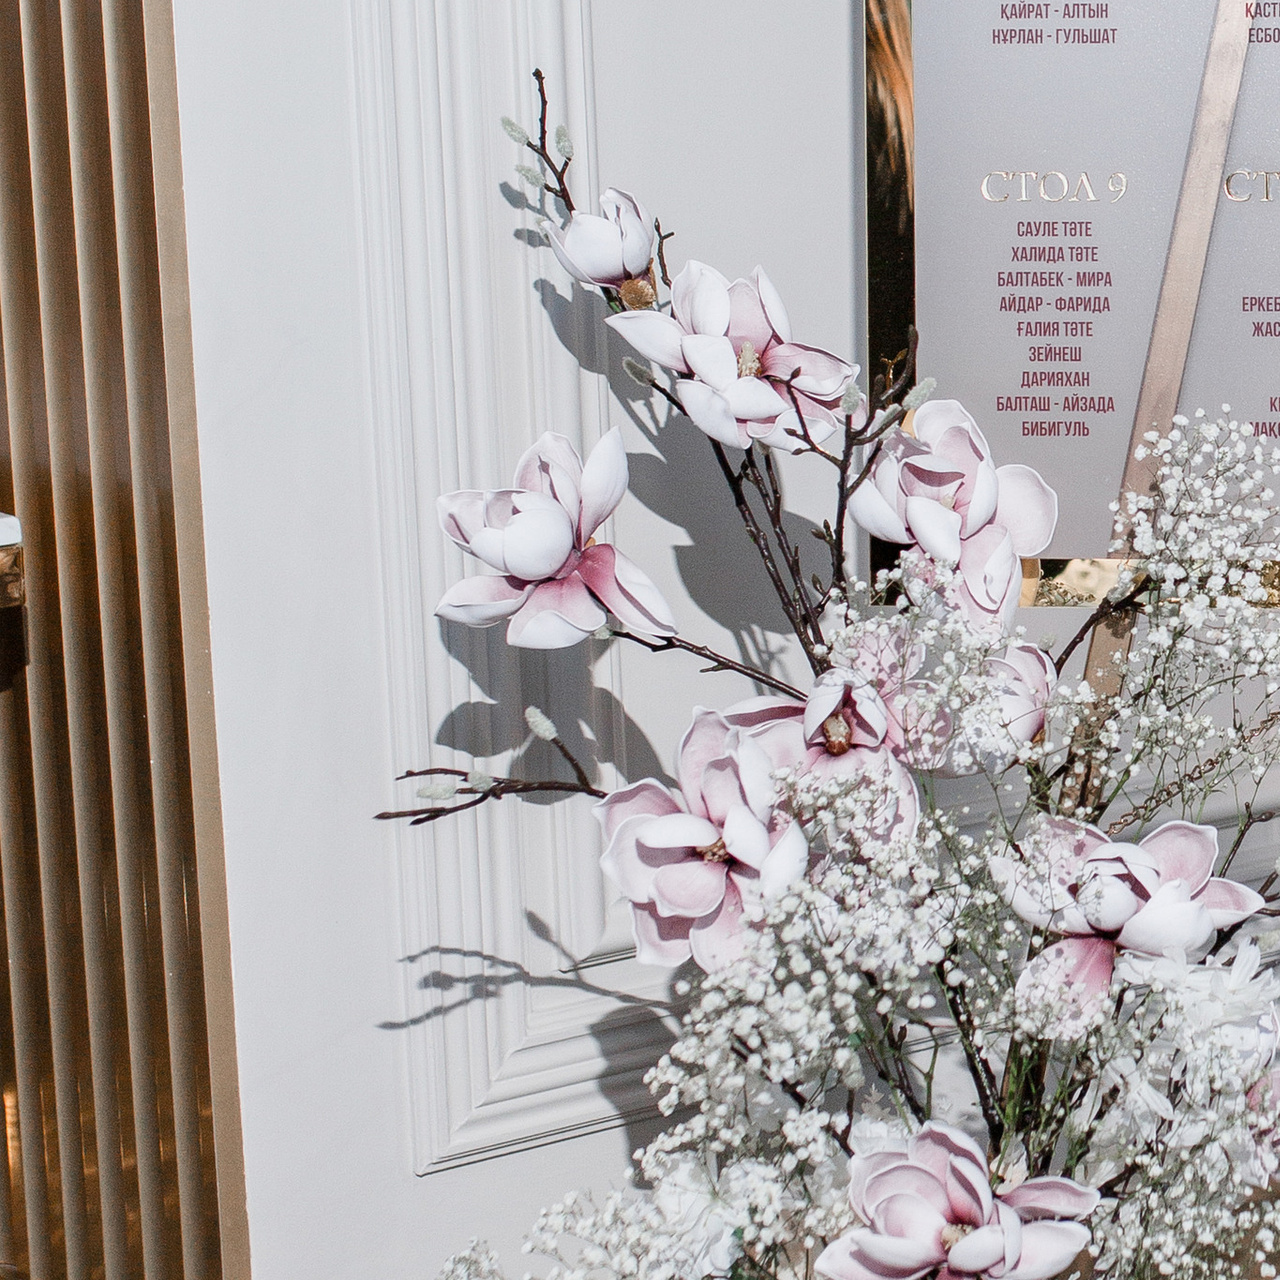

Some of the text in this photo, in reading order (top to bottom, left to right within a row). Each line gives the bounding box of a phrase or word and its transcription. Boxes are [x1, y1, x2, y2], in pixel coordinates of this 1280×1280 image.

[1063, 4, 1108, 18] АЛТЫН
[1056, 29, 1117, 44] ГУЛЬШАТ
[980, 171, 1128, 203] СТОЛ 9
[1017, 222, 1092, 237] САУЛЕ ТӘТЕ
[1011, 247, 1098, 263] ХАЛИДА ТӘТЕ
[998, 272, 1112, 287] БАЛТАБЕК МИРА
[999, 294, 1110, 314] АЙДАР ФАРИДА
[1017, 322, 1093, 337] ҒАЛИЯ ТӘТЕ
[1029, 344, 1081, 362] ЗЕЙНЕШ
[1021, 372, 1090, 388] ДАРИЯХАН
[996, 393, 1115, 413] БАЛТАШ АЙЗАДА
[1022, 421, 1089, 436] БИБИГУЛЬ
